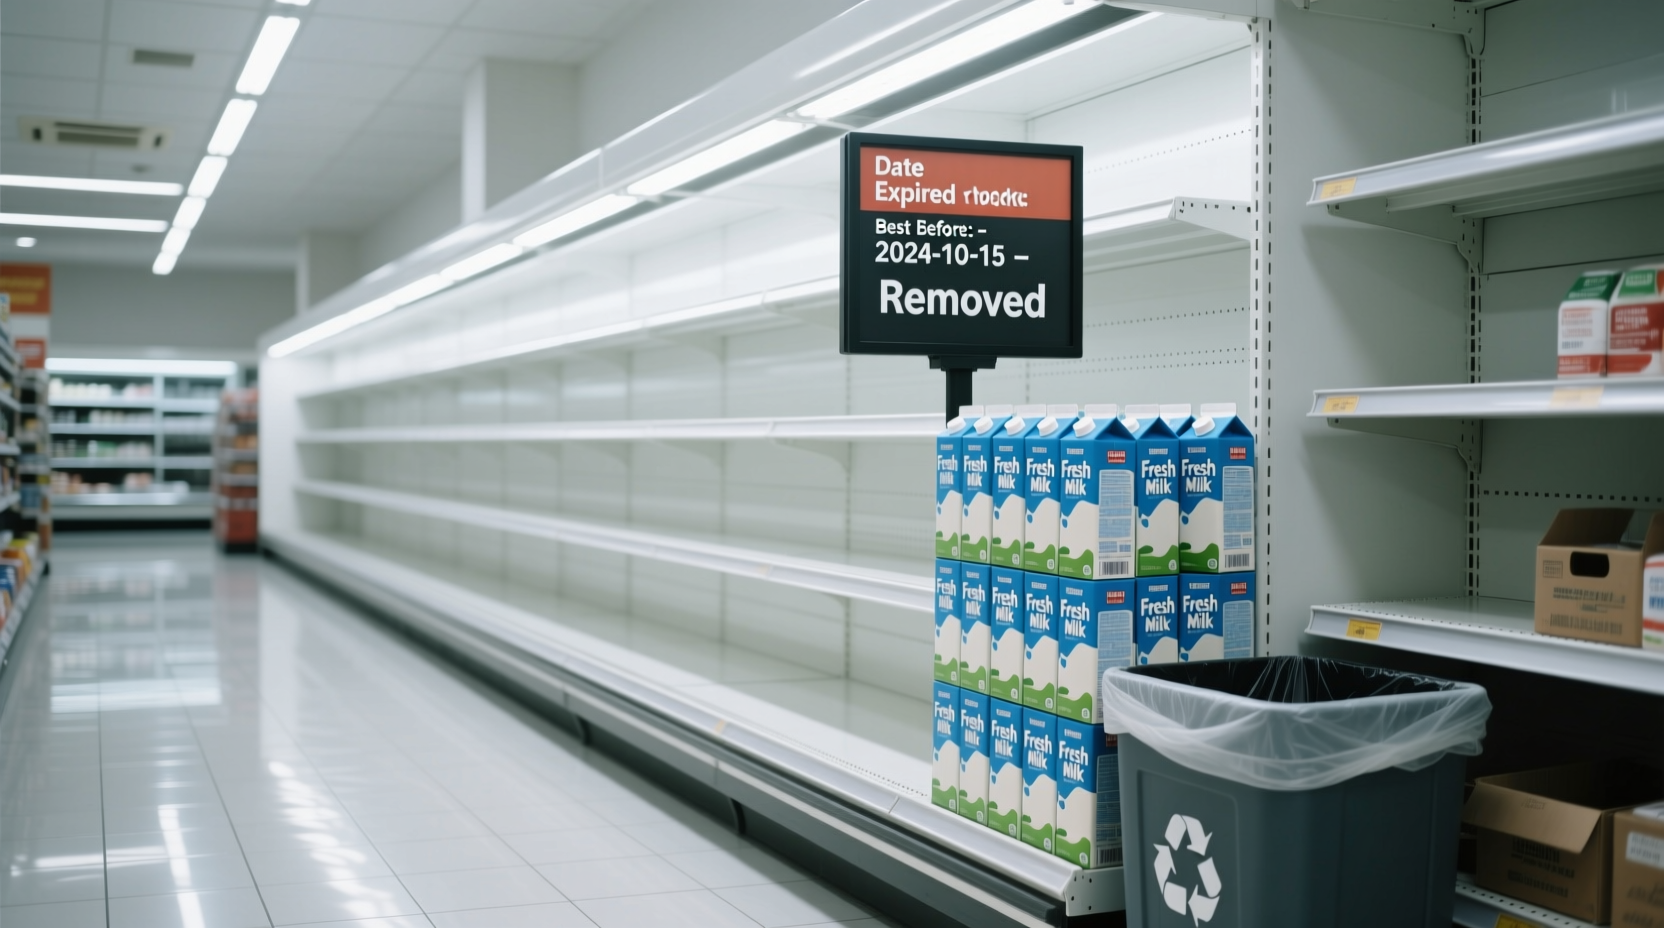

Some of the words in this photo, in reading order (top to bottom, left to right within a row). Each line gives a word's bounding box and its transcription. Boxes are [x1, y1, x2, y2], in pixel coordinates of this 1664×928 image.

[875, 155, 924, 177] Date
[875, 181, 956, 208] Expired
[875, 218, 911, 235] Best
[917, 220, 974, 238] Before:
[875, 240, 1005, 267] 2024-10-15
[880, 279, 1046, 318] Removed
[994, 456, 1019, 474] Fresh
[1027, 458, 1054, 477] Fresh
[1062, 460, 1090, 479] Fresh
[1142, 459, 1176, 478] Fresh
[1182, 458, 1216, 476] Fresh
[1146, 478, 1172, 495] Milk
[1186, 477, 1212, 493] Milk
[1061, 599, 1090, 622] Fresh
[1141, 596, 1175, 616] Fresh
[1183, 594, 1217, 613] Fresh
[1145, 615, 1171, 632] Milk
[1187, 612, 1213, 629] Milk
[1024, 730, 1052, 754] Fresh
[1059, 741, 1088, 766] Fresh
